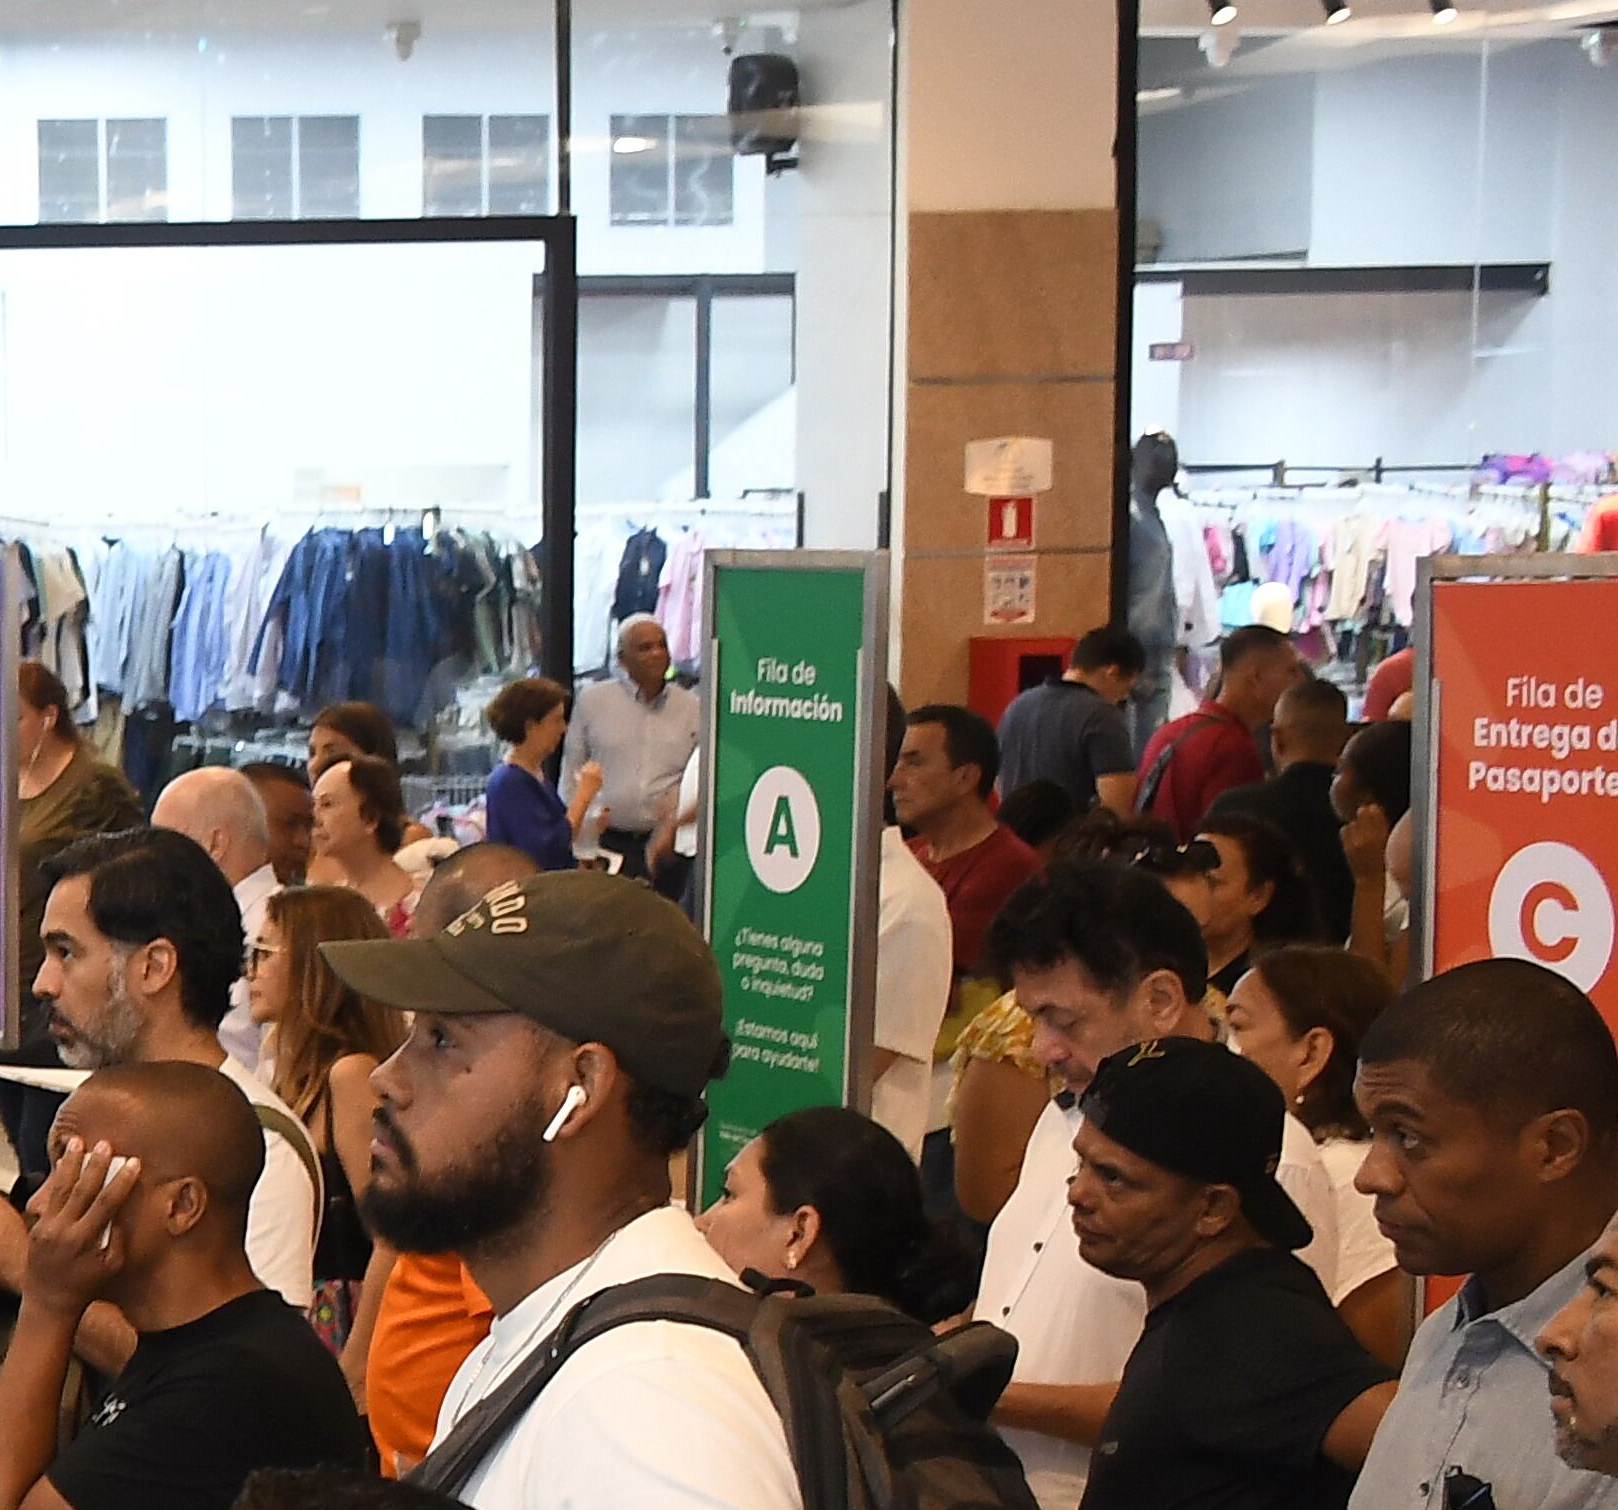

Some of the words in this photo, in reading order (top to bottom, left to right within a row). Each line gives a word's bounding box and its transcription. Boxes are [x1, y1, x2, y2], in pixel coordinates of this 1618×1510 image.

[756, 656, 789, 685] Fila
[791, 660, 817, 686] de
[729, 688, 844, 723] Información
[1505, 675, 1557, 709] Fila
[1564, 677, 1605, 711] de
[1472, 716, 1592, 760] Entrega
[1596, 718, 1618, 752] d
[1468, 760, 1618, 804] Pasaporte
[763, 795, 800, 860] A
[1518, 880, 1581, 963] C
[735, 927, 778, 950] ¿Tienes
[780, 934, 825, 959] alguna
[732, 950, 789, 977] pregunta,
[791, 958, 825, 981] duda
[740, 975, 750, 991] o
[751, 975, 814, 1002] inquietud?
[731, 1041, 760, 1061] para
[762, 1047, 820, 1074] ayudarte!
[789, 1030, 819, 1051] aquí
